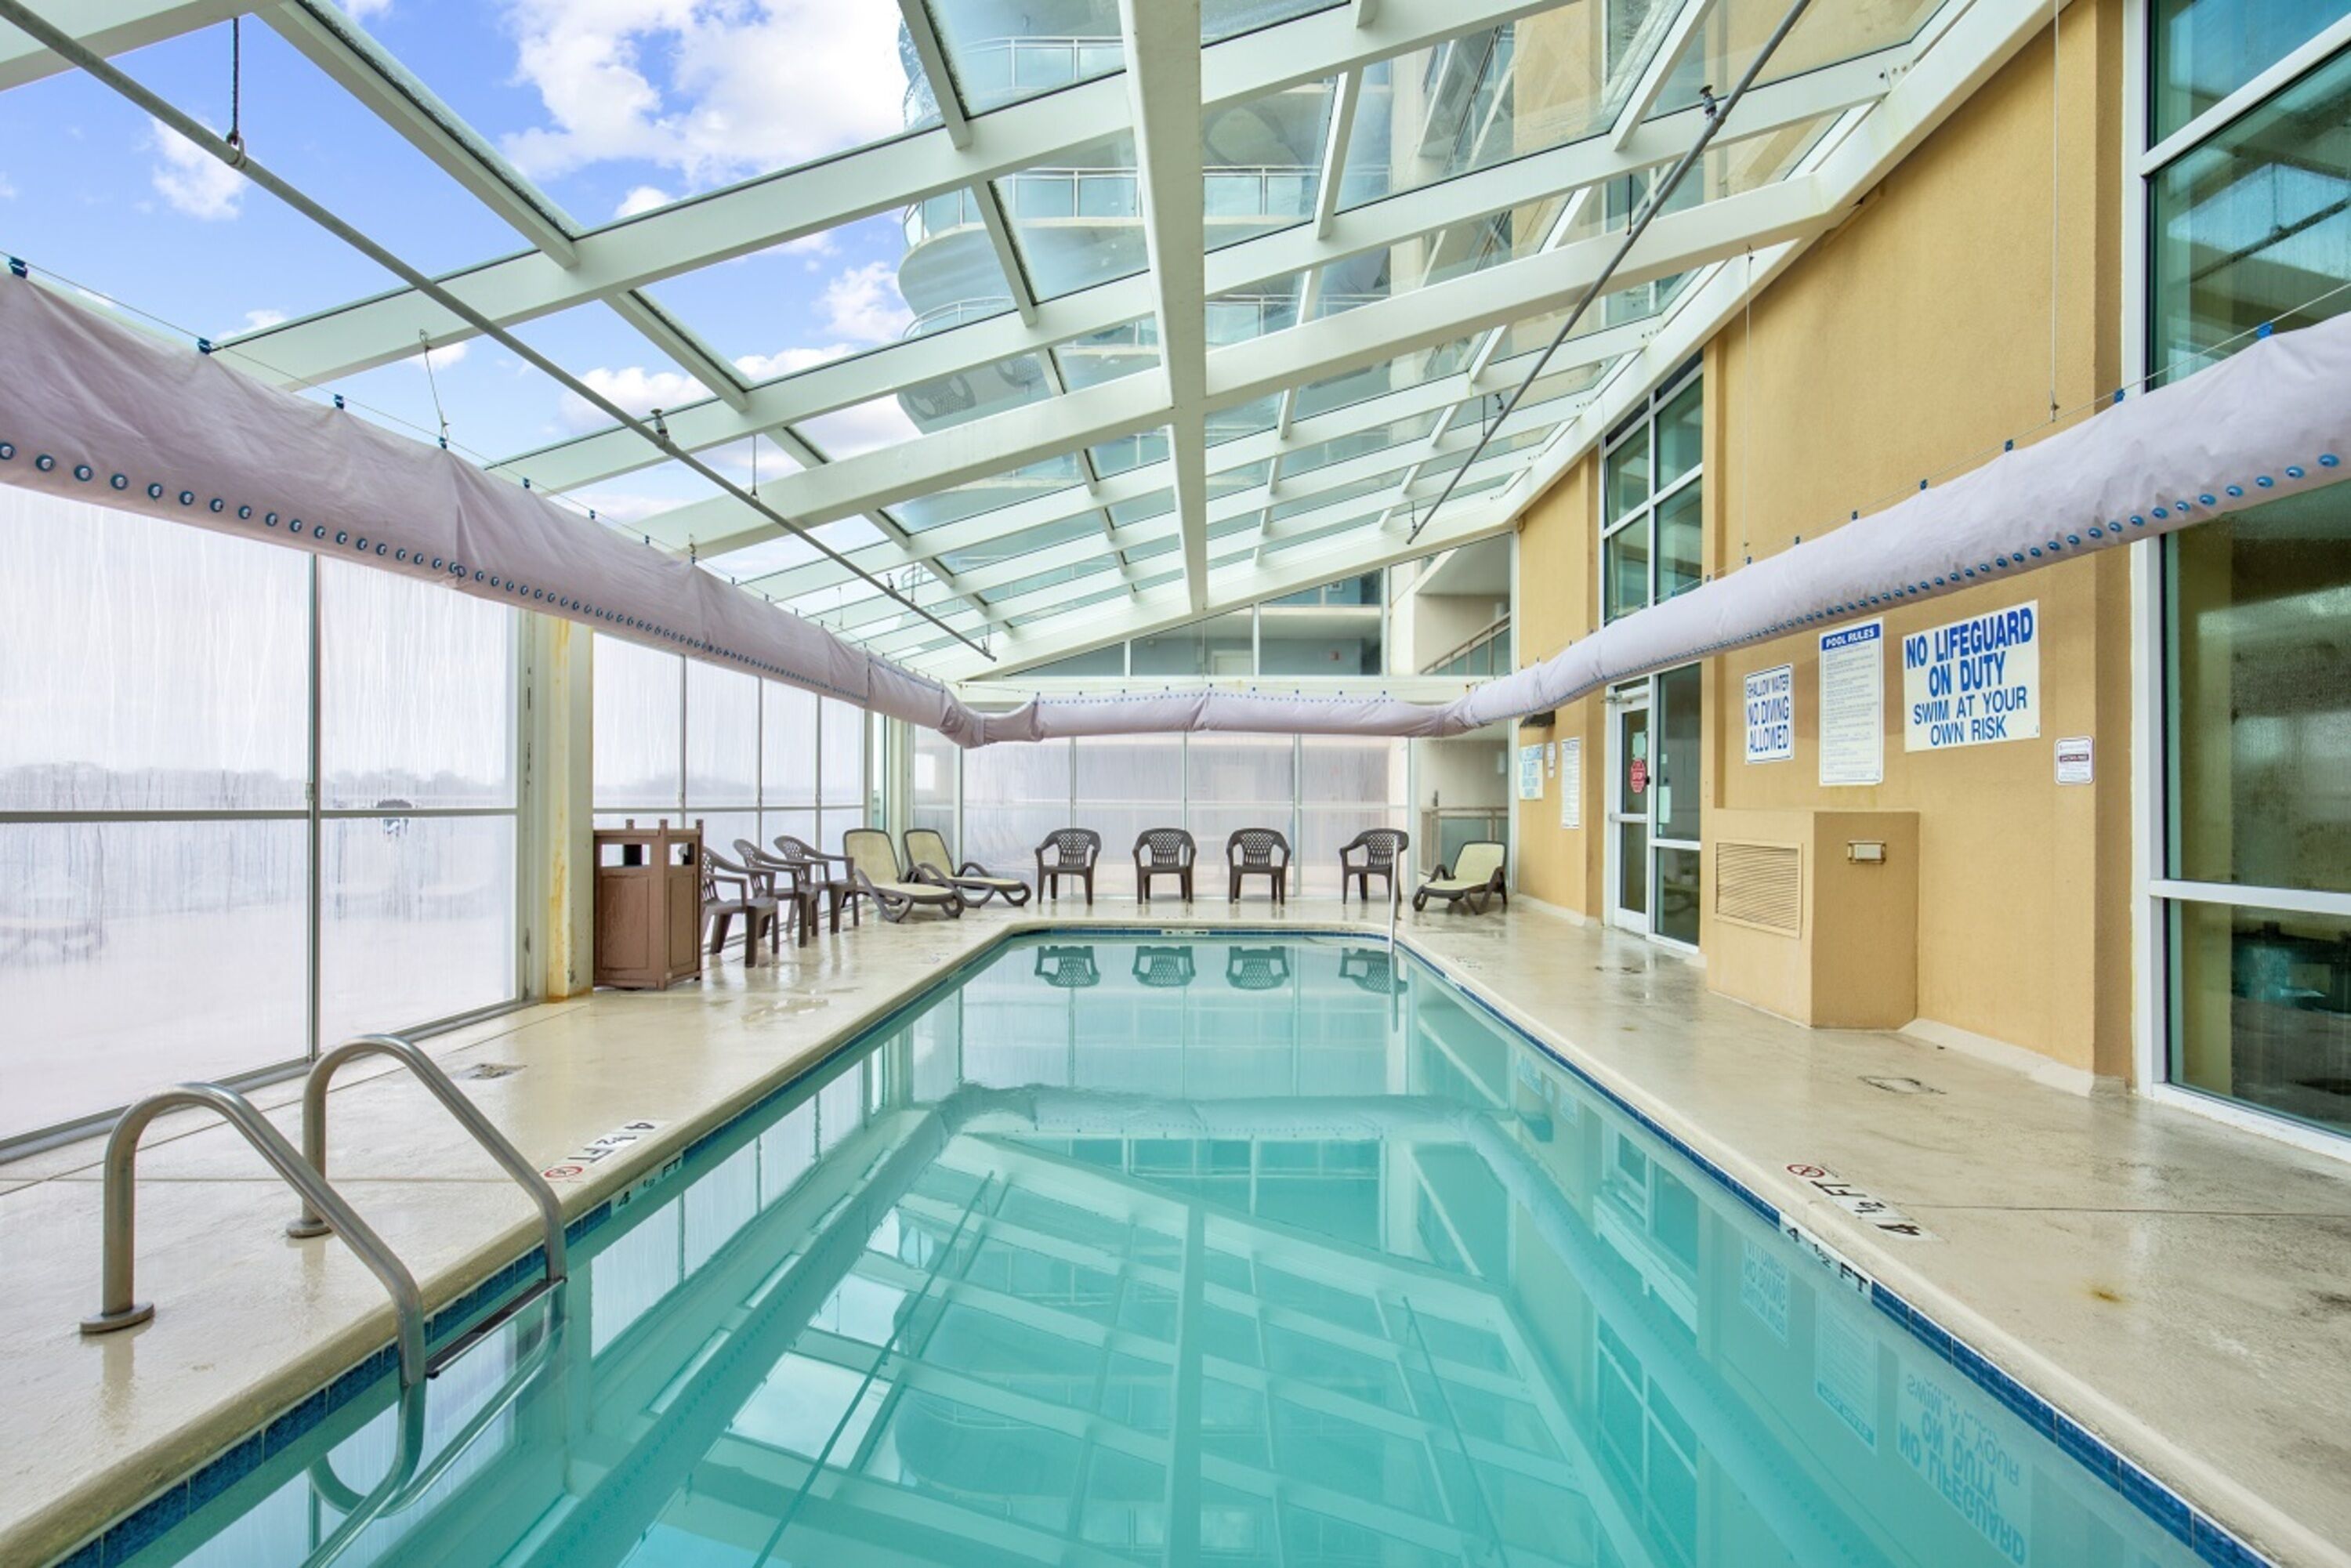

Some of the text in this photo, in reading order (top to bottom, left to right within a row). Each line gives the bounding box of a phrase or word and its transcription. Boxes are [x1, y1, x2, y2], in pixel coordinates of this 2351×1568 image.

[1826, 627, 1875, 648] POOL RULES
[1906, 607, 2033, 669] NO LIFEGUARD
[1929, 650, 2006, 697] ON DUTY
[1748, 695, 1789, 726] NO DIVING
[1914, 686, 2027, 725] SWIM AT YOUR
[1748, 724, 1789, 753] ALLOWED
[1931, 722, 1964, 745] OWN
[1972, 715, 2007, 741] RISK
[567, 1147, 614, 1164] FT
[1810, 1180, 1867, 1197] FT
[1787, 1227, 1799, 1243] 4
[1840, 1262, 1868, 1293] FT
